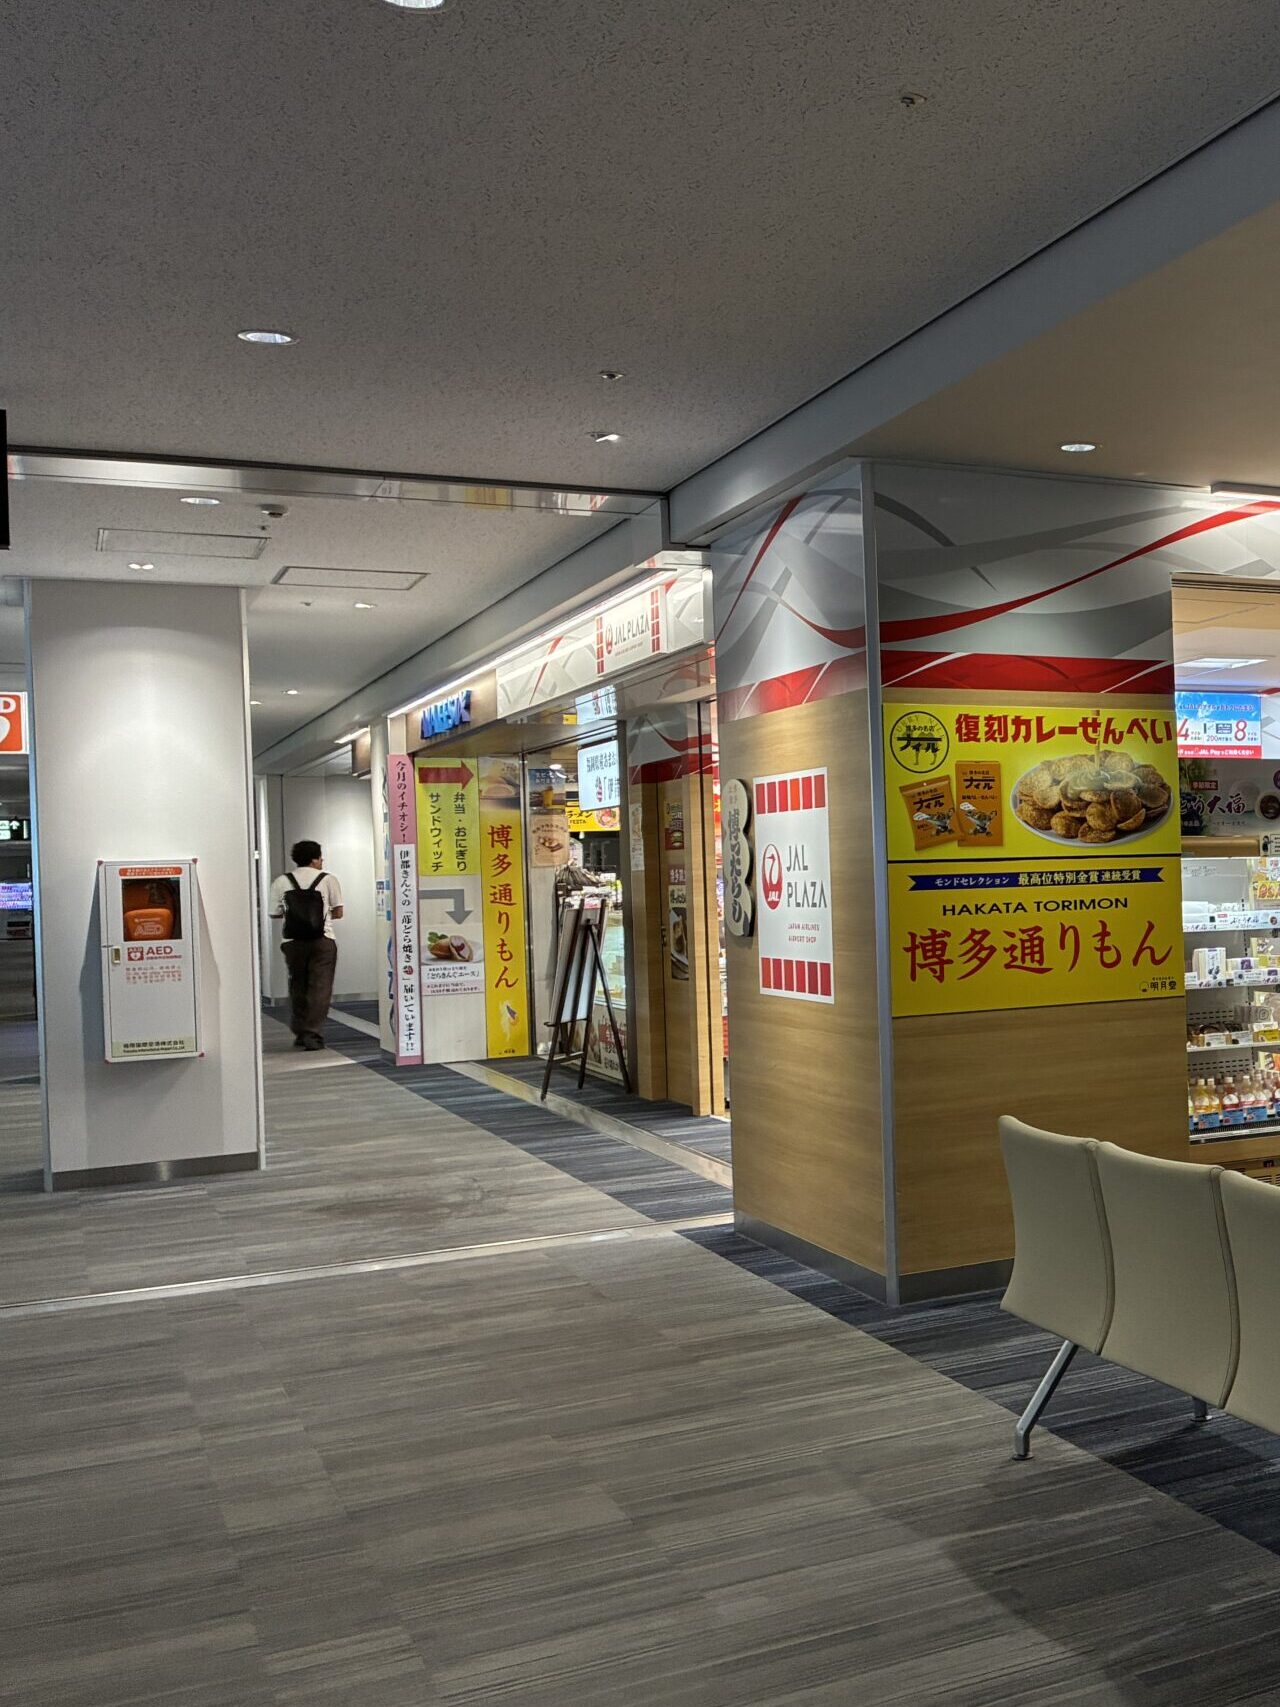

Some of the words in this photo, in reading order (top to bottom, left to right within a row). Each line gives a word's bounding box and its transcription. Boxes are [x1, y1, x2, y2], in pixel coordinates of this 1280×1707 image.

[614, 624, 627, 645] JAL
[627, 611, 650, 640] PLAZA
[955, 713, 1173, 745] 復刻カレーせんべい
[1234, 719, 1248, 742] 8
[428, 792, 444, 873] サンドウィッチ
[454, 791, 468, 872] 弁当・おにぎり
[786, 844, 808, 873] JAL
[767, 890, 779, 901] JAL
[787, 879, 827, 909] PLAZA
[934, 875, 1010, 887] モンドセレクション
[487, 824, 519, 989] 博多通りもん
[942, 901, 1028, 916] HAKATA
[1034, 897, 1128, 913] TORIMON
[146, 945, 173, 956] AED
[903, 919, 1174, 984] 博多通りもん
